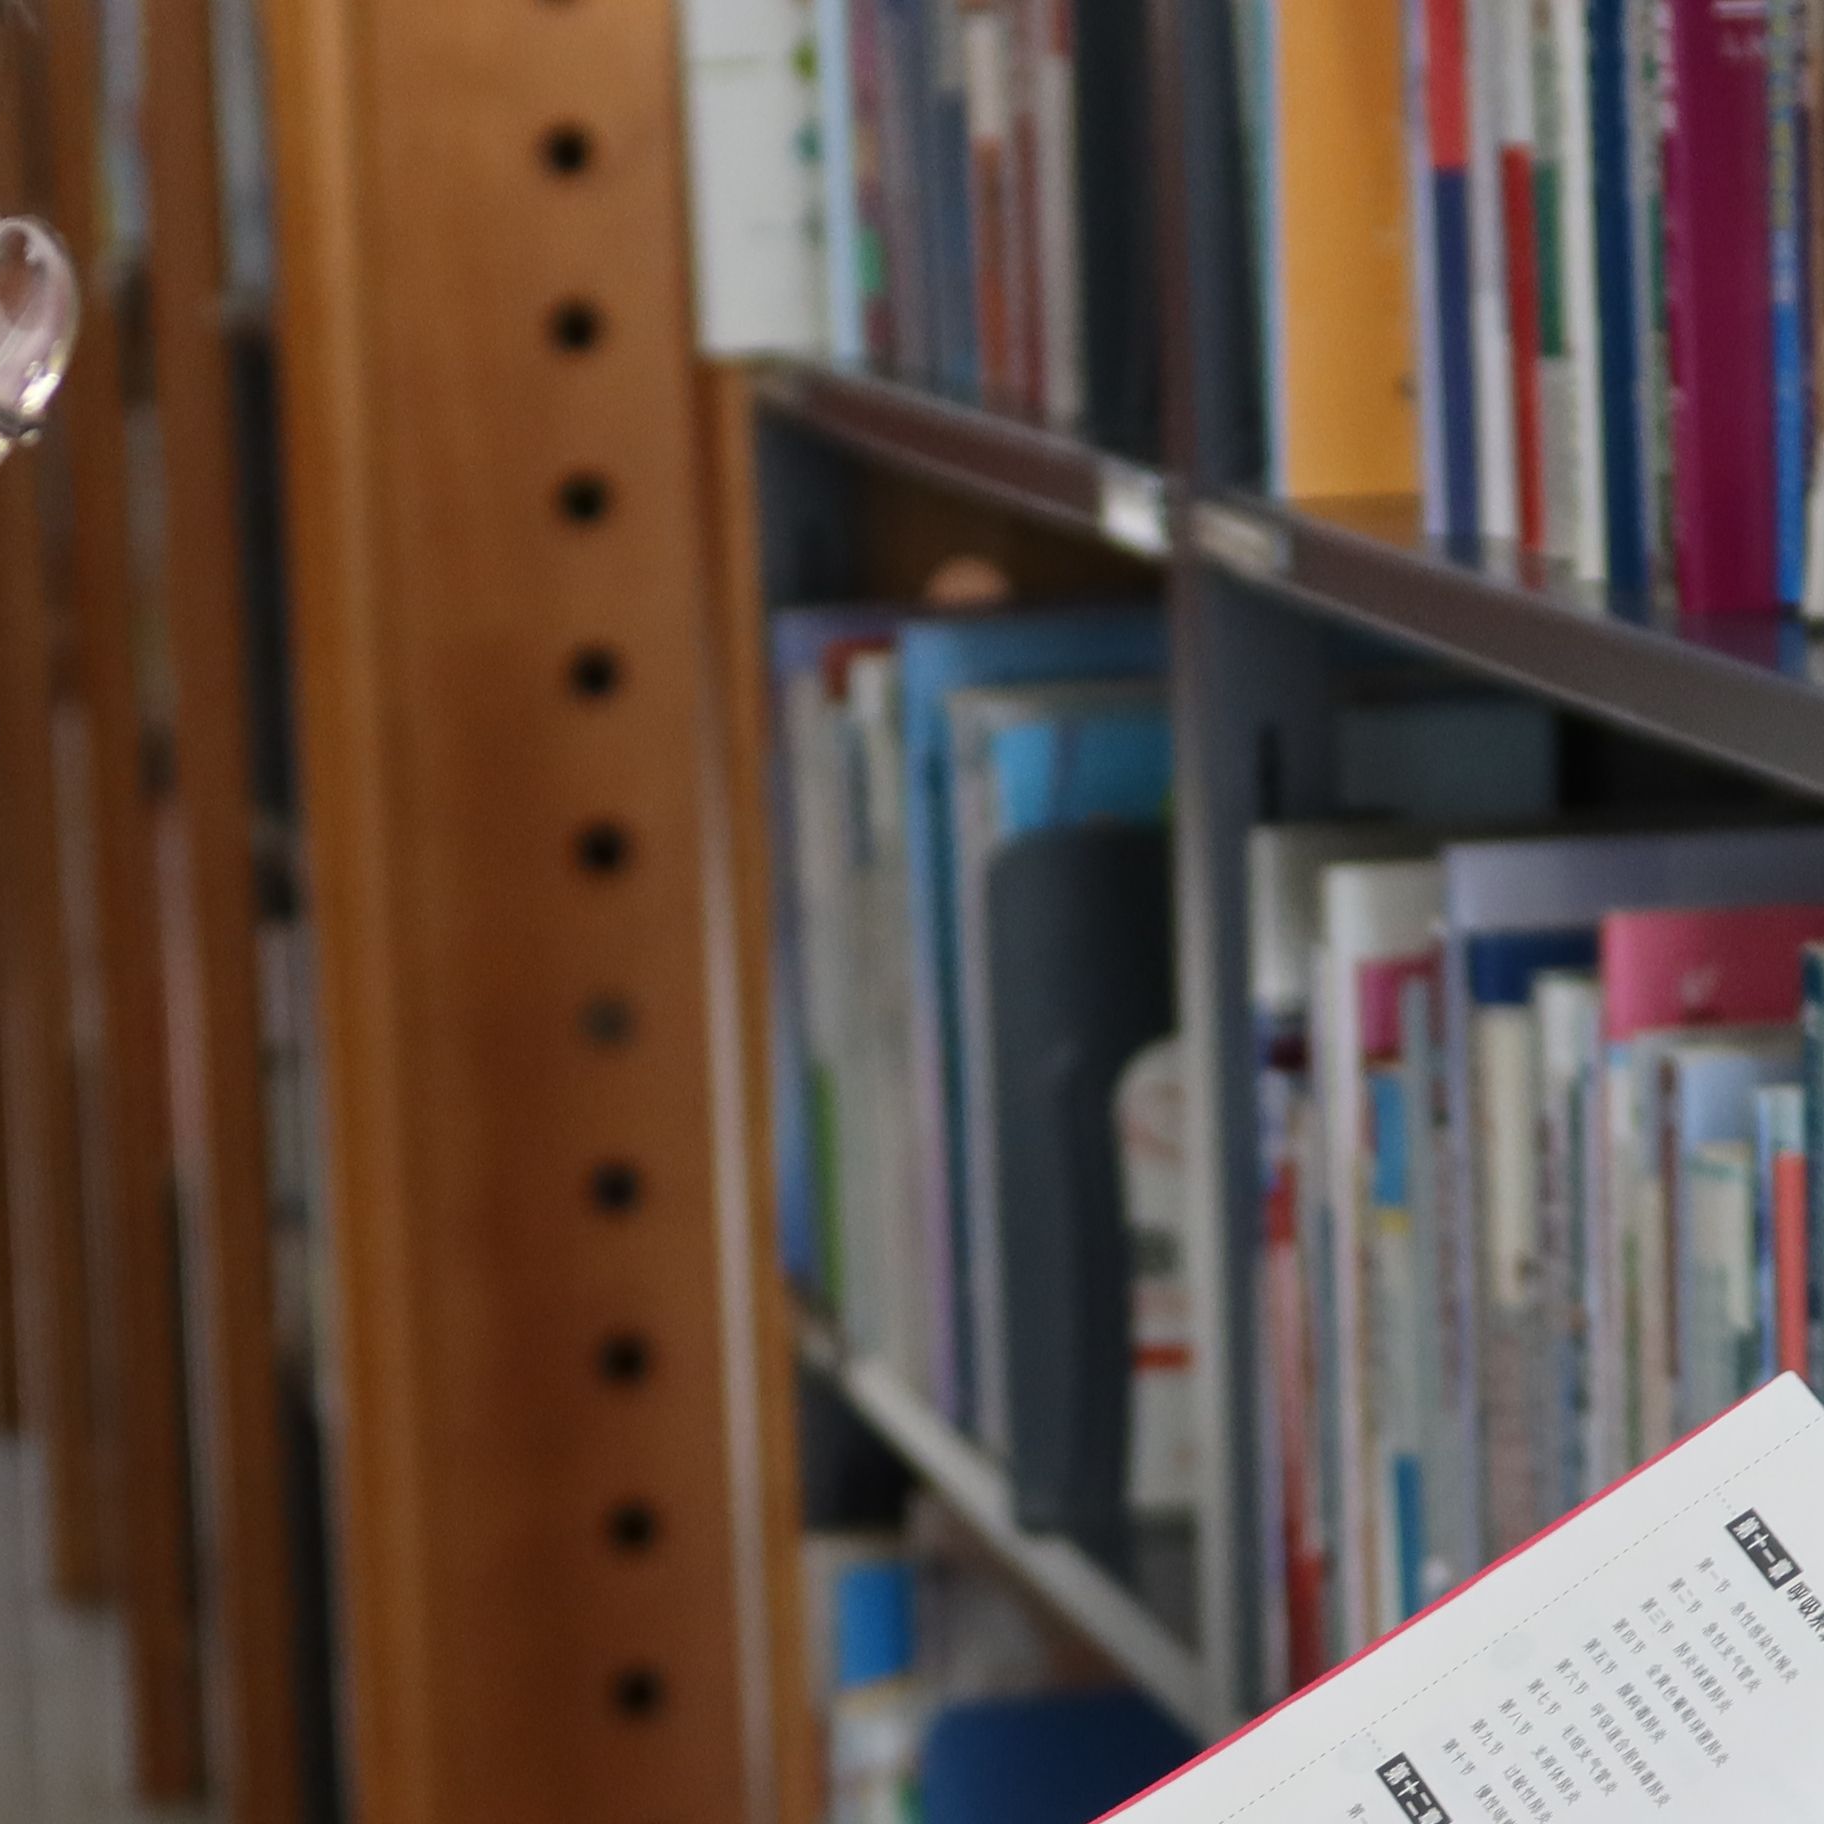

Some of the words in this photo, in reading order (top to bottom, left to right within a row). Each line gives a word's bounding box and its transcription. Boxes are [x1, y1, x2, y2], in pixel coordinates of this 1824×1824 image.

[1730, 1512, 1797, 1586] 第十一章
[1695, 1556, 1732, 1593] 第一节
[1611, 1617, 1646, 1655] 第四节
[1667, 1577, 1703, 1614] 第二节
[1702, 1621, 1762, 1694] 急性支气管炎
[1583, 1637, 1618, 1675] 第五节
[1639, 1596, 1675, 1635] 第三节
[1672, 1640, 1734, 1714] 肺炎球菌肺炎
[1526, 1678, 1562, 1716] 第七节
[1469, 1718, 1505, 1756] 第九节
[1497, 1697, 1534, 1736] 第八节
[1530, 1745, 1581, 1807] 支原体肺炎
[1554, 1657, 1590, 1695] 第六节
[1590, 1702, 1672, 1809] 呼吸道合胞病毒肺炎
[1441, 1738, 1476, 1776] 第十节
